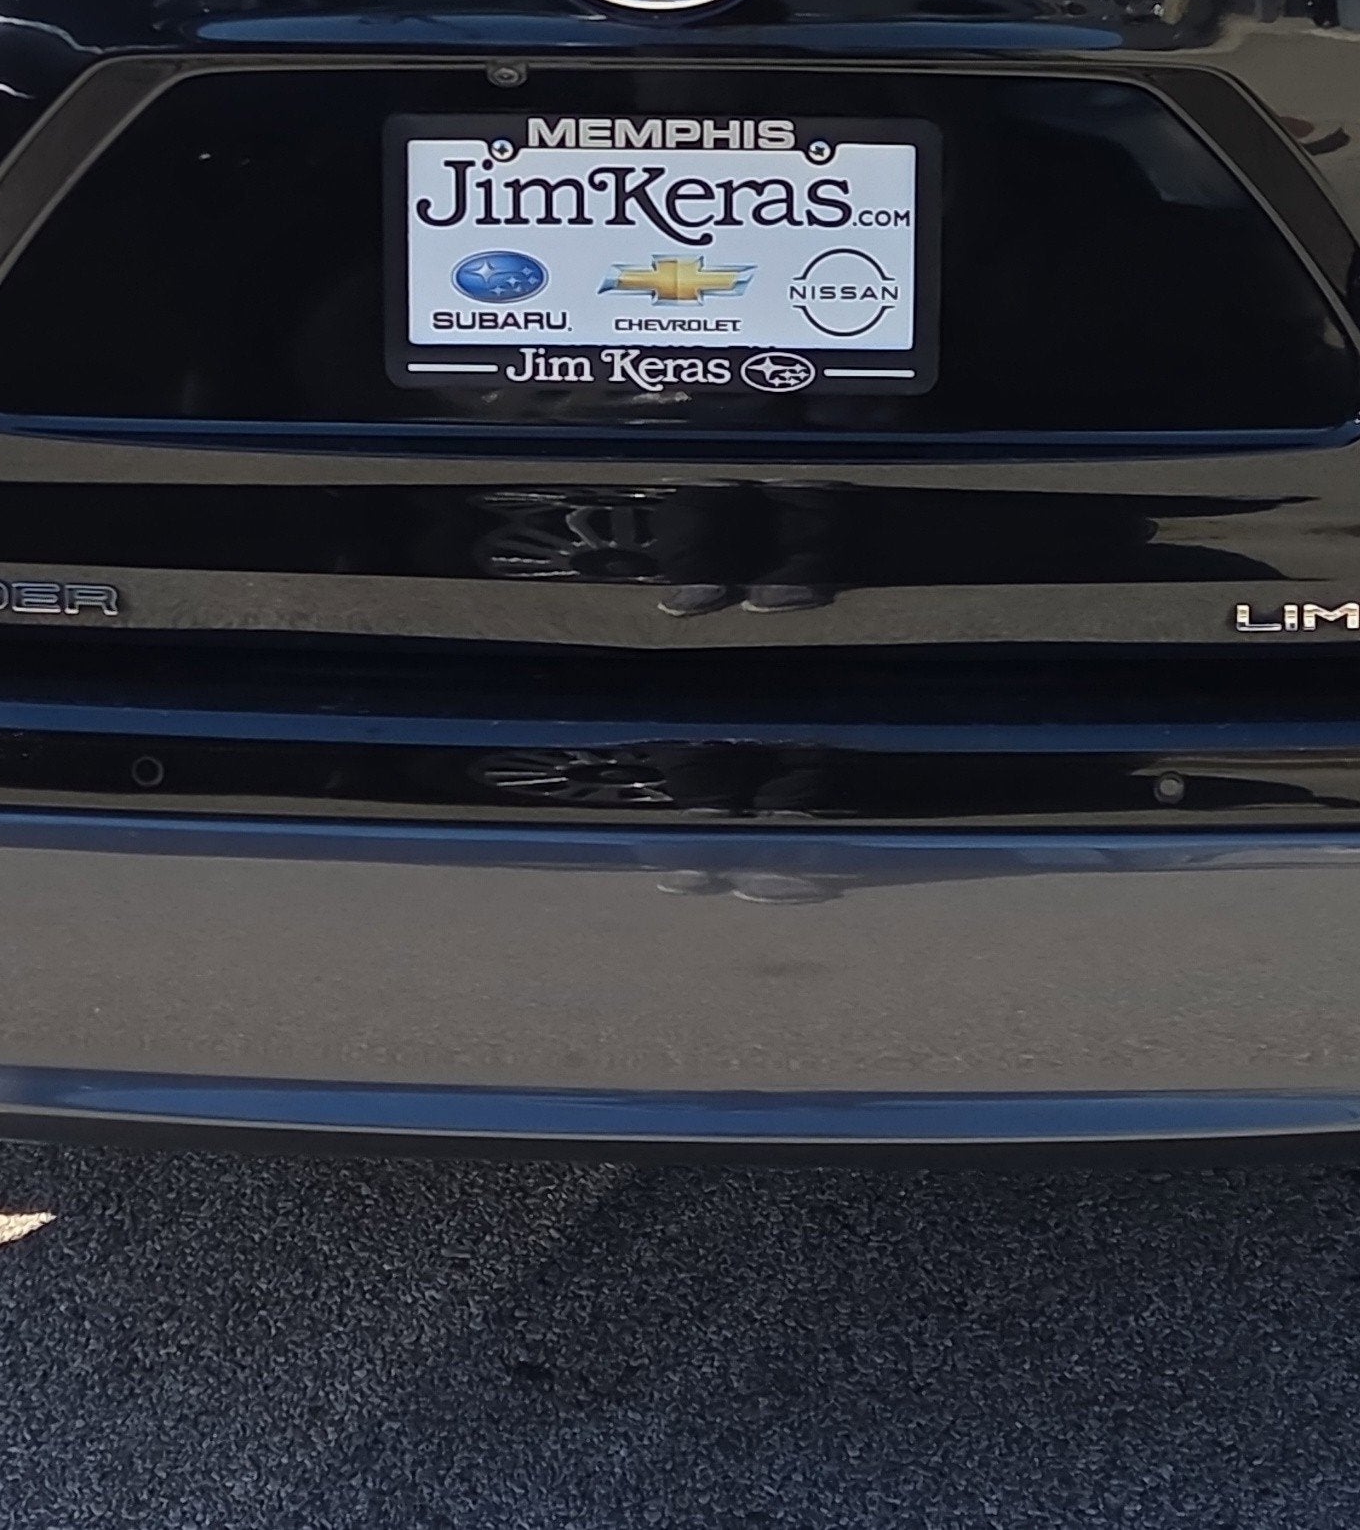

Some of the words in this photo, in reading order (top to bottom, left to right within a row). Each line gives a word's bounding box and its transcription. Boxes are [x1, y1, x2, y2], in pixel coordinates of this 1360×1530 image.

[527, 117, 796, 150] MEMPHIS
[789, 285, 899, 301] NISSAN
[432, 311, 568, 330] SUBARU
[614, 318, 741, 332] CHEVROLET
[505, 347, 595, 383] Jim
[600, 348, 732, 392] Keras
